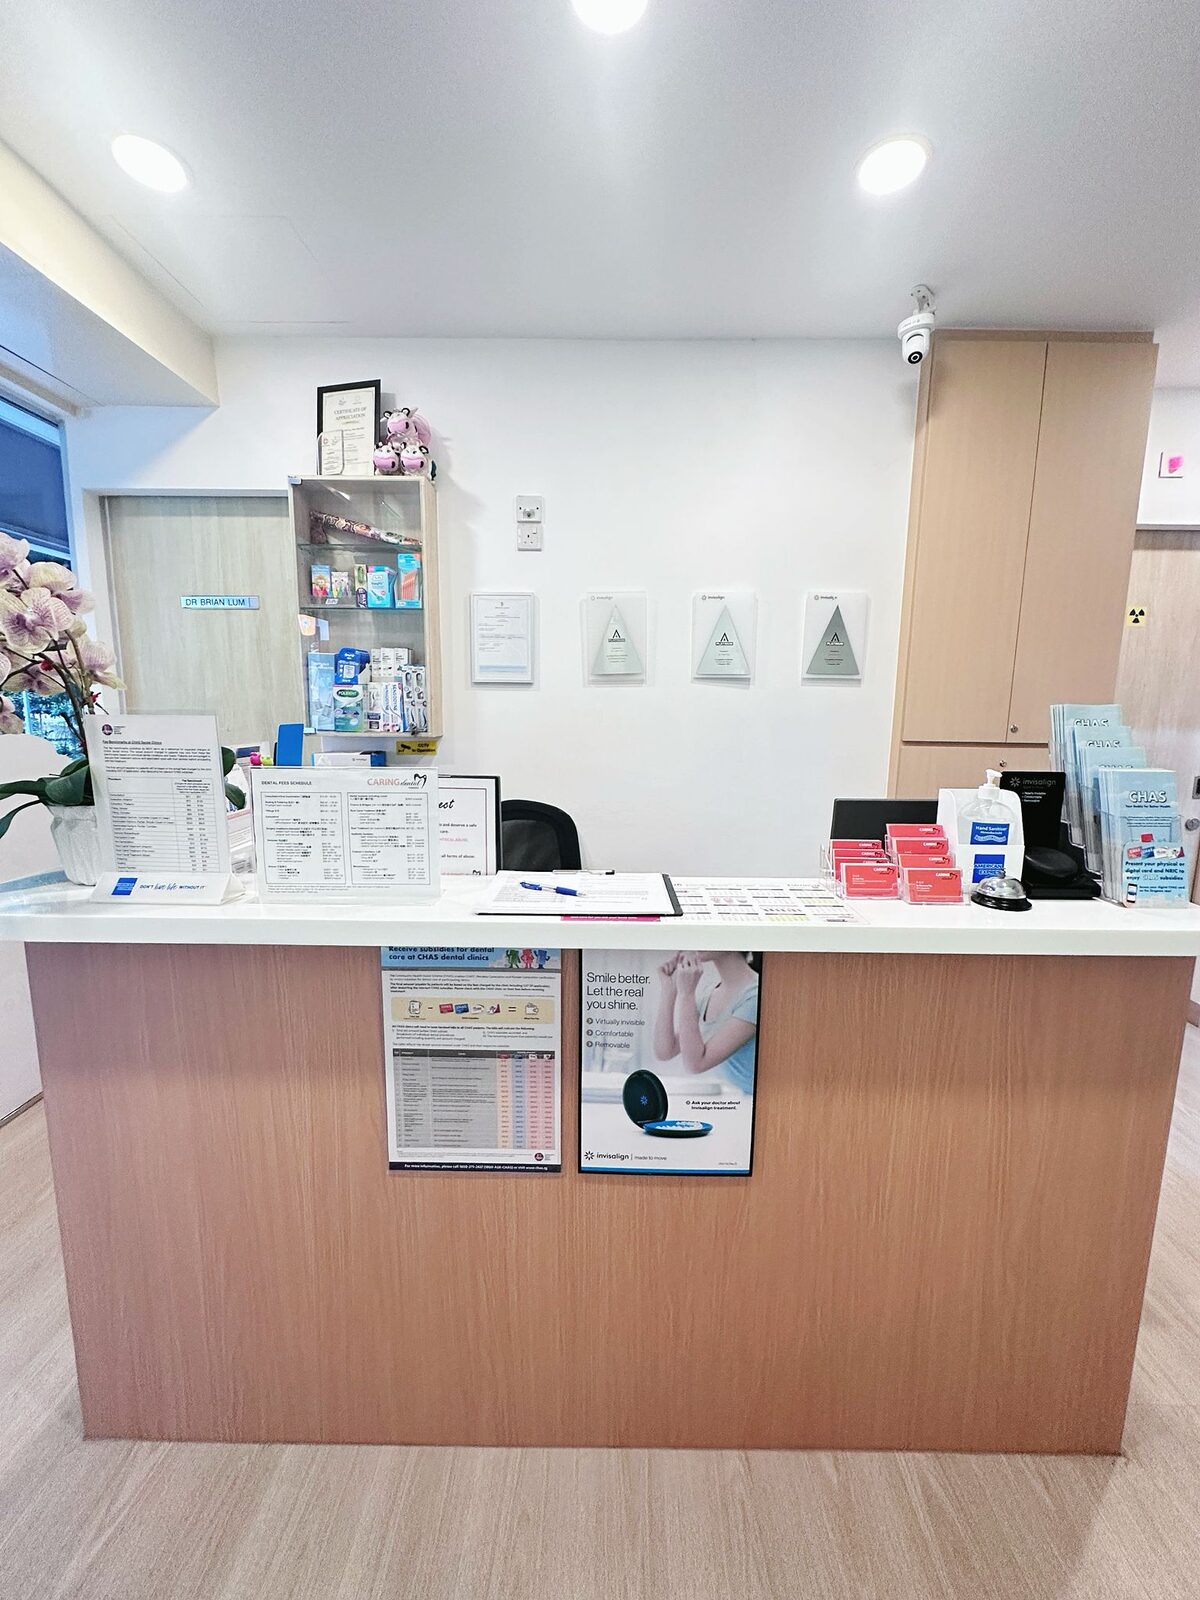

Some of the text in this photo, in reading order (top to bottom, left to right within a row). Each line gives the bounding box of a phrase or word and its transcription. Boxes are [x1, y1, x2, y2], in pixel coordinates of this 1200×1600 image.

[1023, 779, 1056, 788] invisalign
[1130, 790, 1167, 803] CHAS
[586, 972, 650, 984] Smile better.
[587, 986, 644, 997] Let the real
[586, 1000, 638, 1011] you shine.
[596, 1018, 620, 1026] Virtually
[596, 1152, 630, 1161] invisalign
